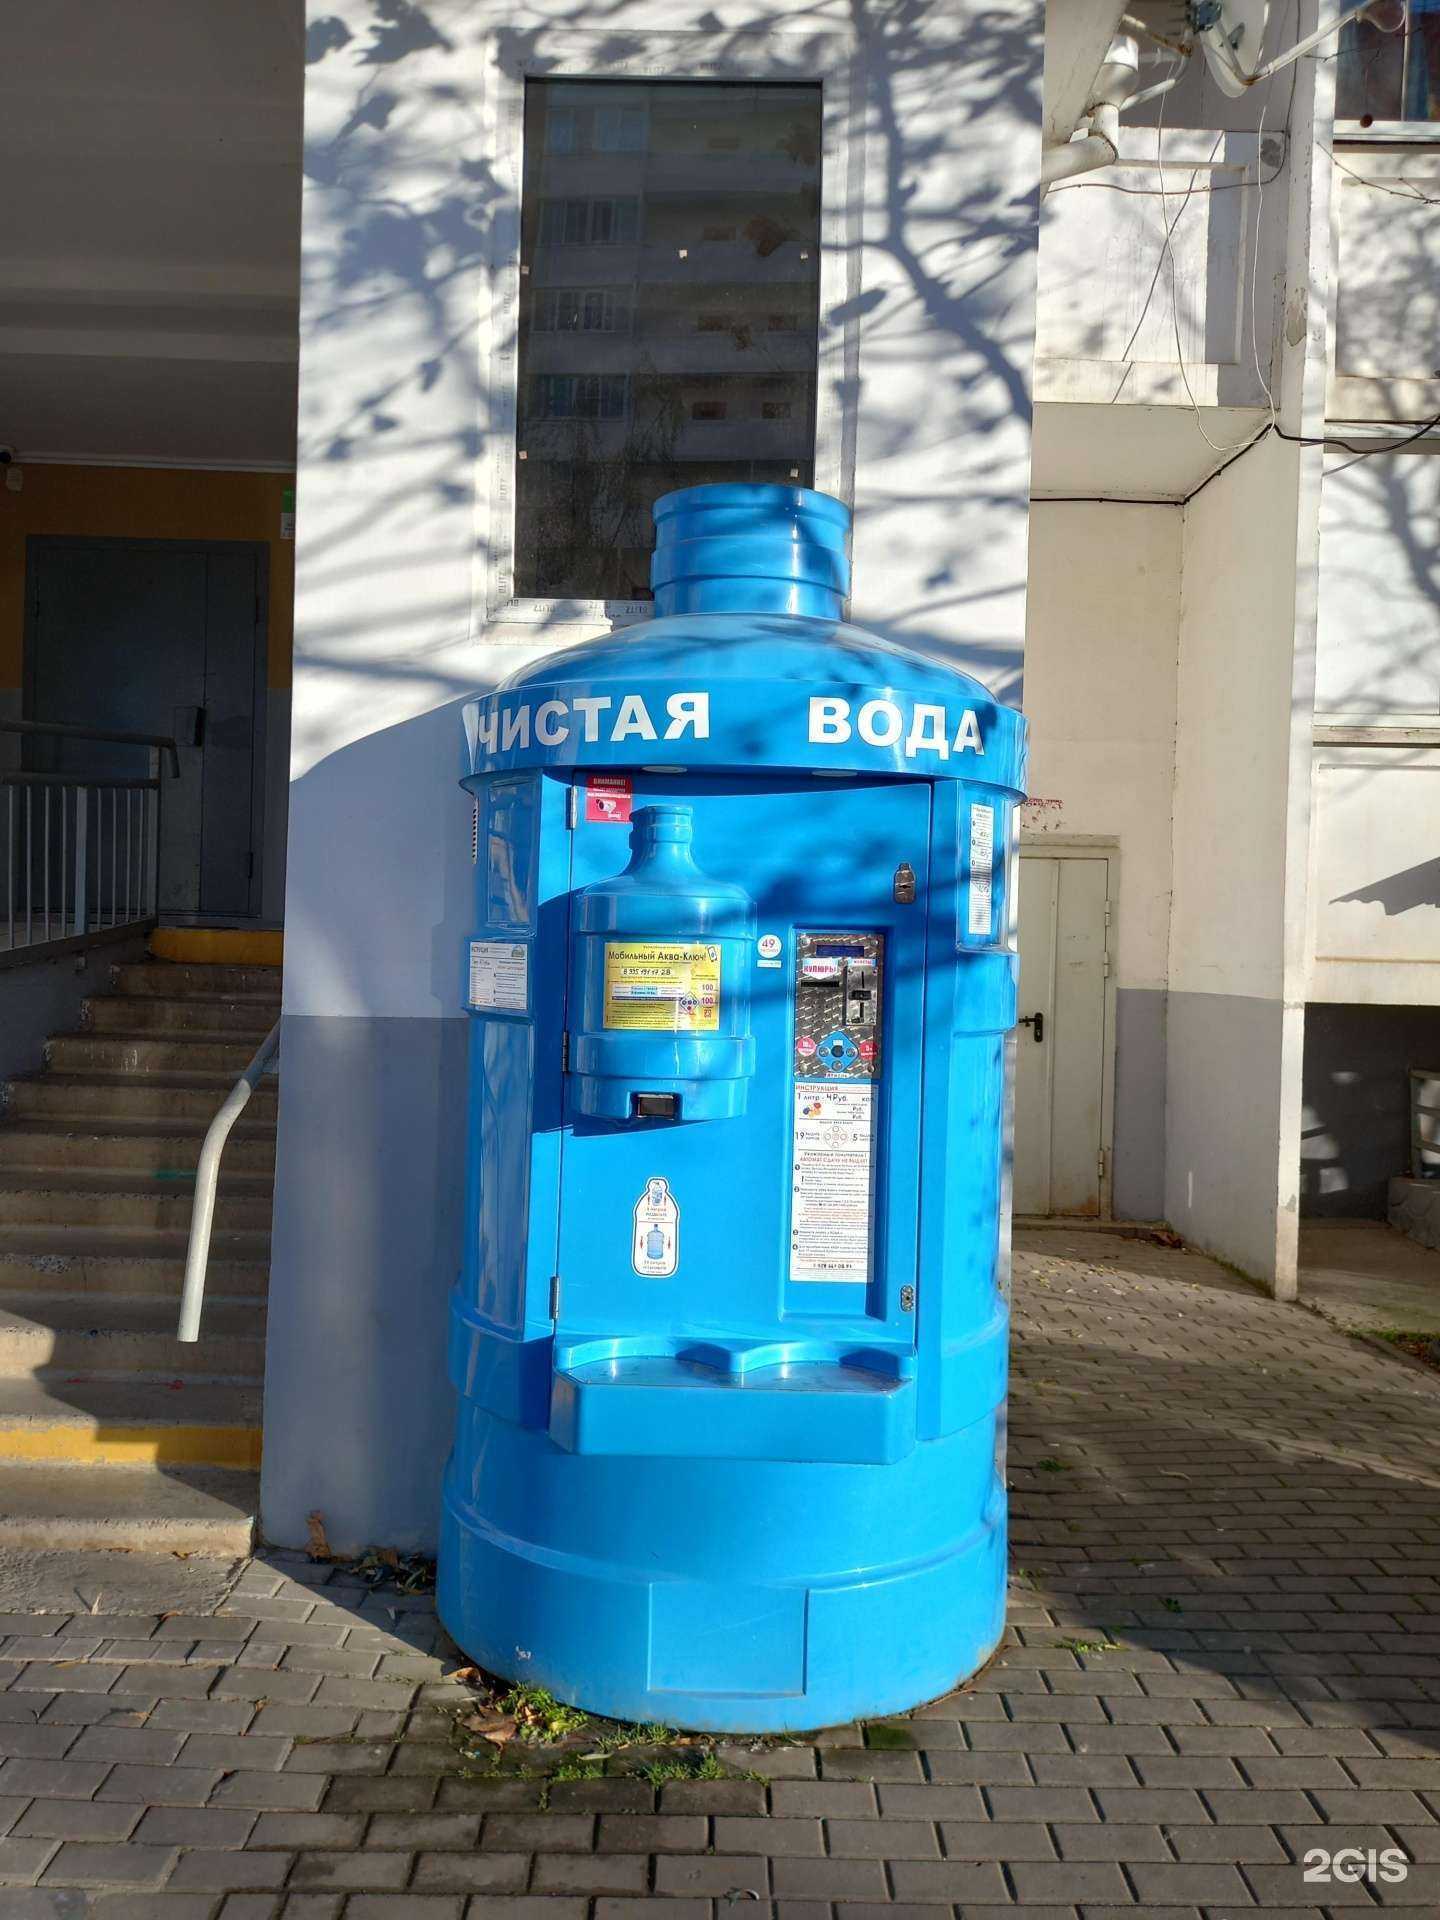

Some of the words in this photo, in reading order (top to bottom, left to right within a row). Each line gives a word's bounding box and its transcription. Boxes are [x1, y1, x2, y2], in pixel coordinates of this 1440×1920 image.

[478, 692, 709, 754] ЧИСТАЯ
[808, 695, 985, 760] ВОДА
[761, 938, 775, 948] 49
[608, 950, 655, 961] Мобильный
[657, 951, 706, 962] Аква-Ключ!
